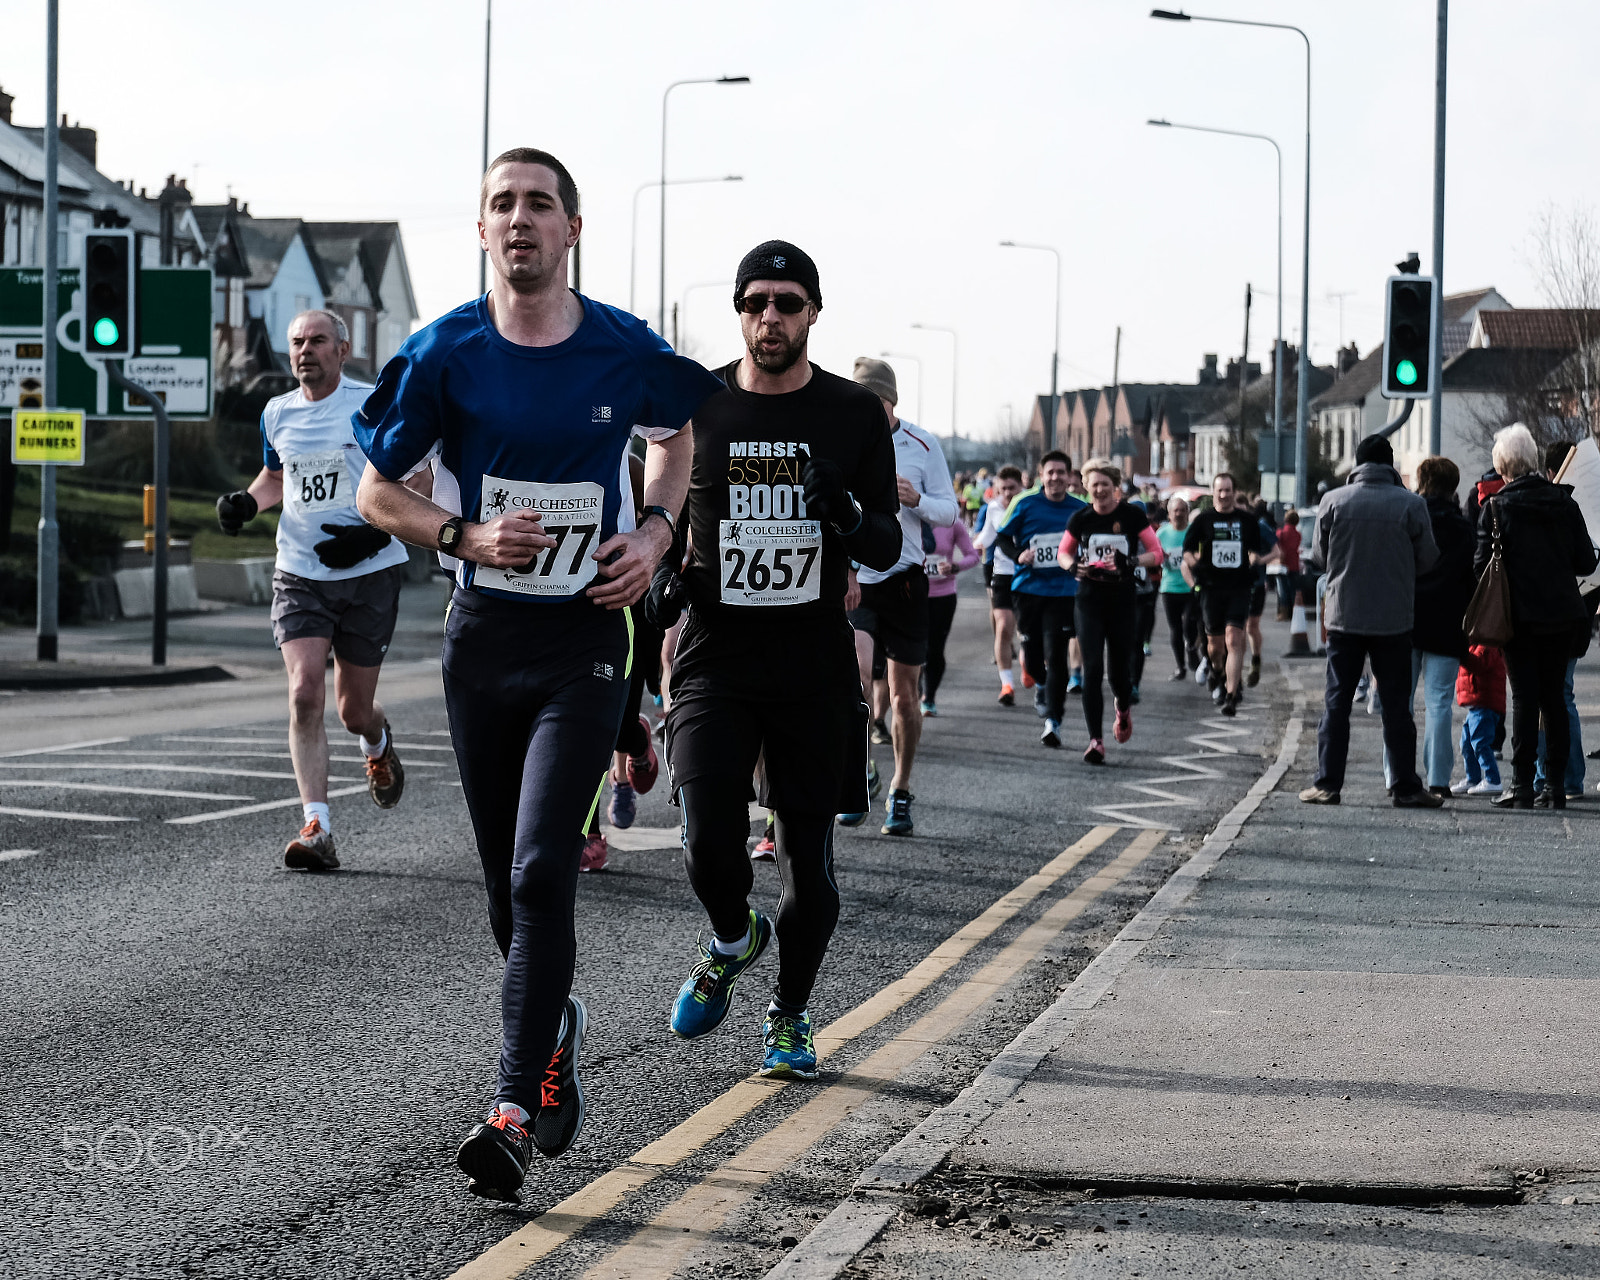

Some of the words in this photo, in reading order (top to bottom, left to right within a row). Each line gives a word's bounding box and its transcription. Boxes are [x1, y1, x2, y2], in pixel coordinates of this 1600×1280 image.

[17, 272, 43, 284] Tow
[22, 419, 75, 431] CAUTION
[19, 437, 76, 449] RUNNERS
[302, 471, 339, 503] 687
[512, 496, 598, 510] COLCHESTER
[543, 512, 596, 521] MARATHON
[745, 525, 817, 535] COLCHESTER
[771, 537, 817, 545] MARATHON
[511, 523, 598, 577] 77
[724, 546, 820, 592] 2657
[512, 580, 539, 590] GRIFFIN
[539, 583, 571, 591] CHAPMAN
